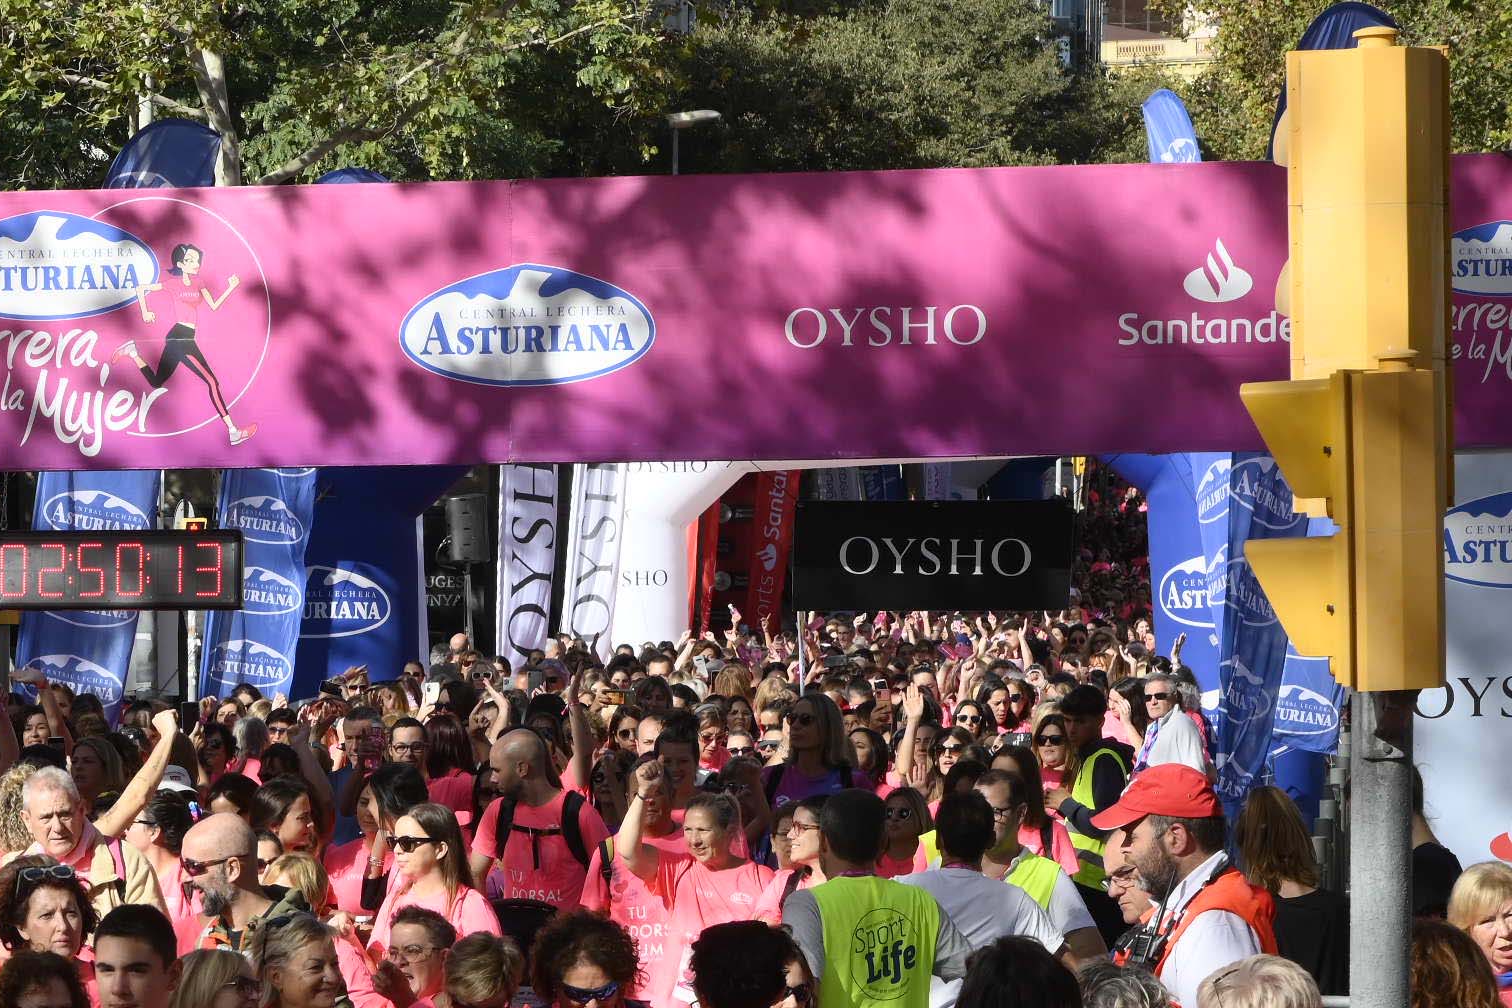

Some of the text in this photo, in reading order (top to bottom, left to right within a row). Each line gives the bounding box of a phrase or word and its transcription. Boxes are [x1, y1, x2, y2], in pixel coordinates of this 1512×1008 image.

[62, 247, 134, 258] LECHERA
[1452, 258, 1512, 278] STUR
[459, 305, 627, 319] CENTRAL LECHERA
[784, 304, 987, 349] OYSHO
[1117, 310, 1291, 346] Santande
[420, 311, 635, 356] ASTURIANA
[1452, 343, 1463, 360] e
[1468, 332, 1486, 360] la
[1, 371, 25, 411] la
[20, 363, 168, 457] Mujer
[764, 470, 788, 541] Santa
[0, 544, 222, 597] 02:50:13
[507, 463, 555, 658] OYSH
[571, 462, 619, 643] OYSH
[838, 536, 1032, 577] OYSHO
[622, 569, 668, 586] SHO
[243, 589, 294, 607] URIANA
[302, 601, 382, 620] URIANA
[1275, 707, 1332, 727] TURIANA
[628, 906, 647, 919] TU
[629, 924, 671, 937] DORS
[855, 915, 906, 953] Sport
[865, 940, 916, 984] Life
